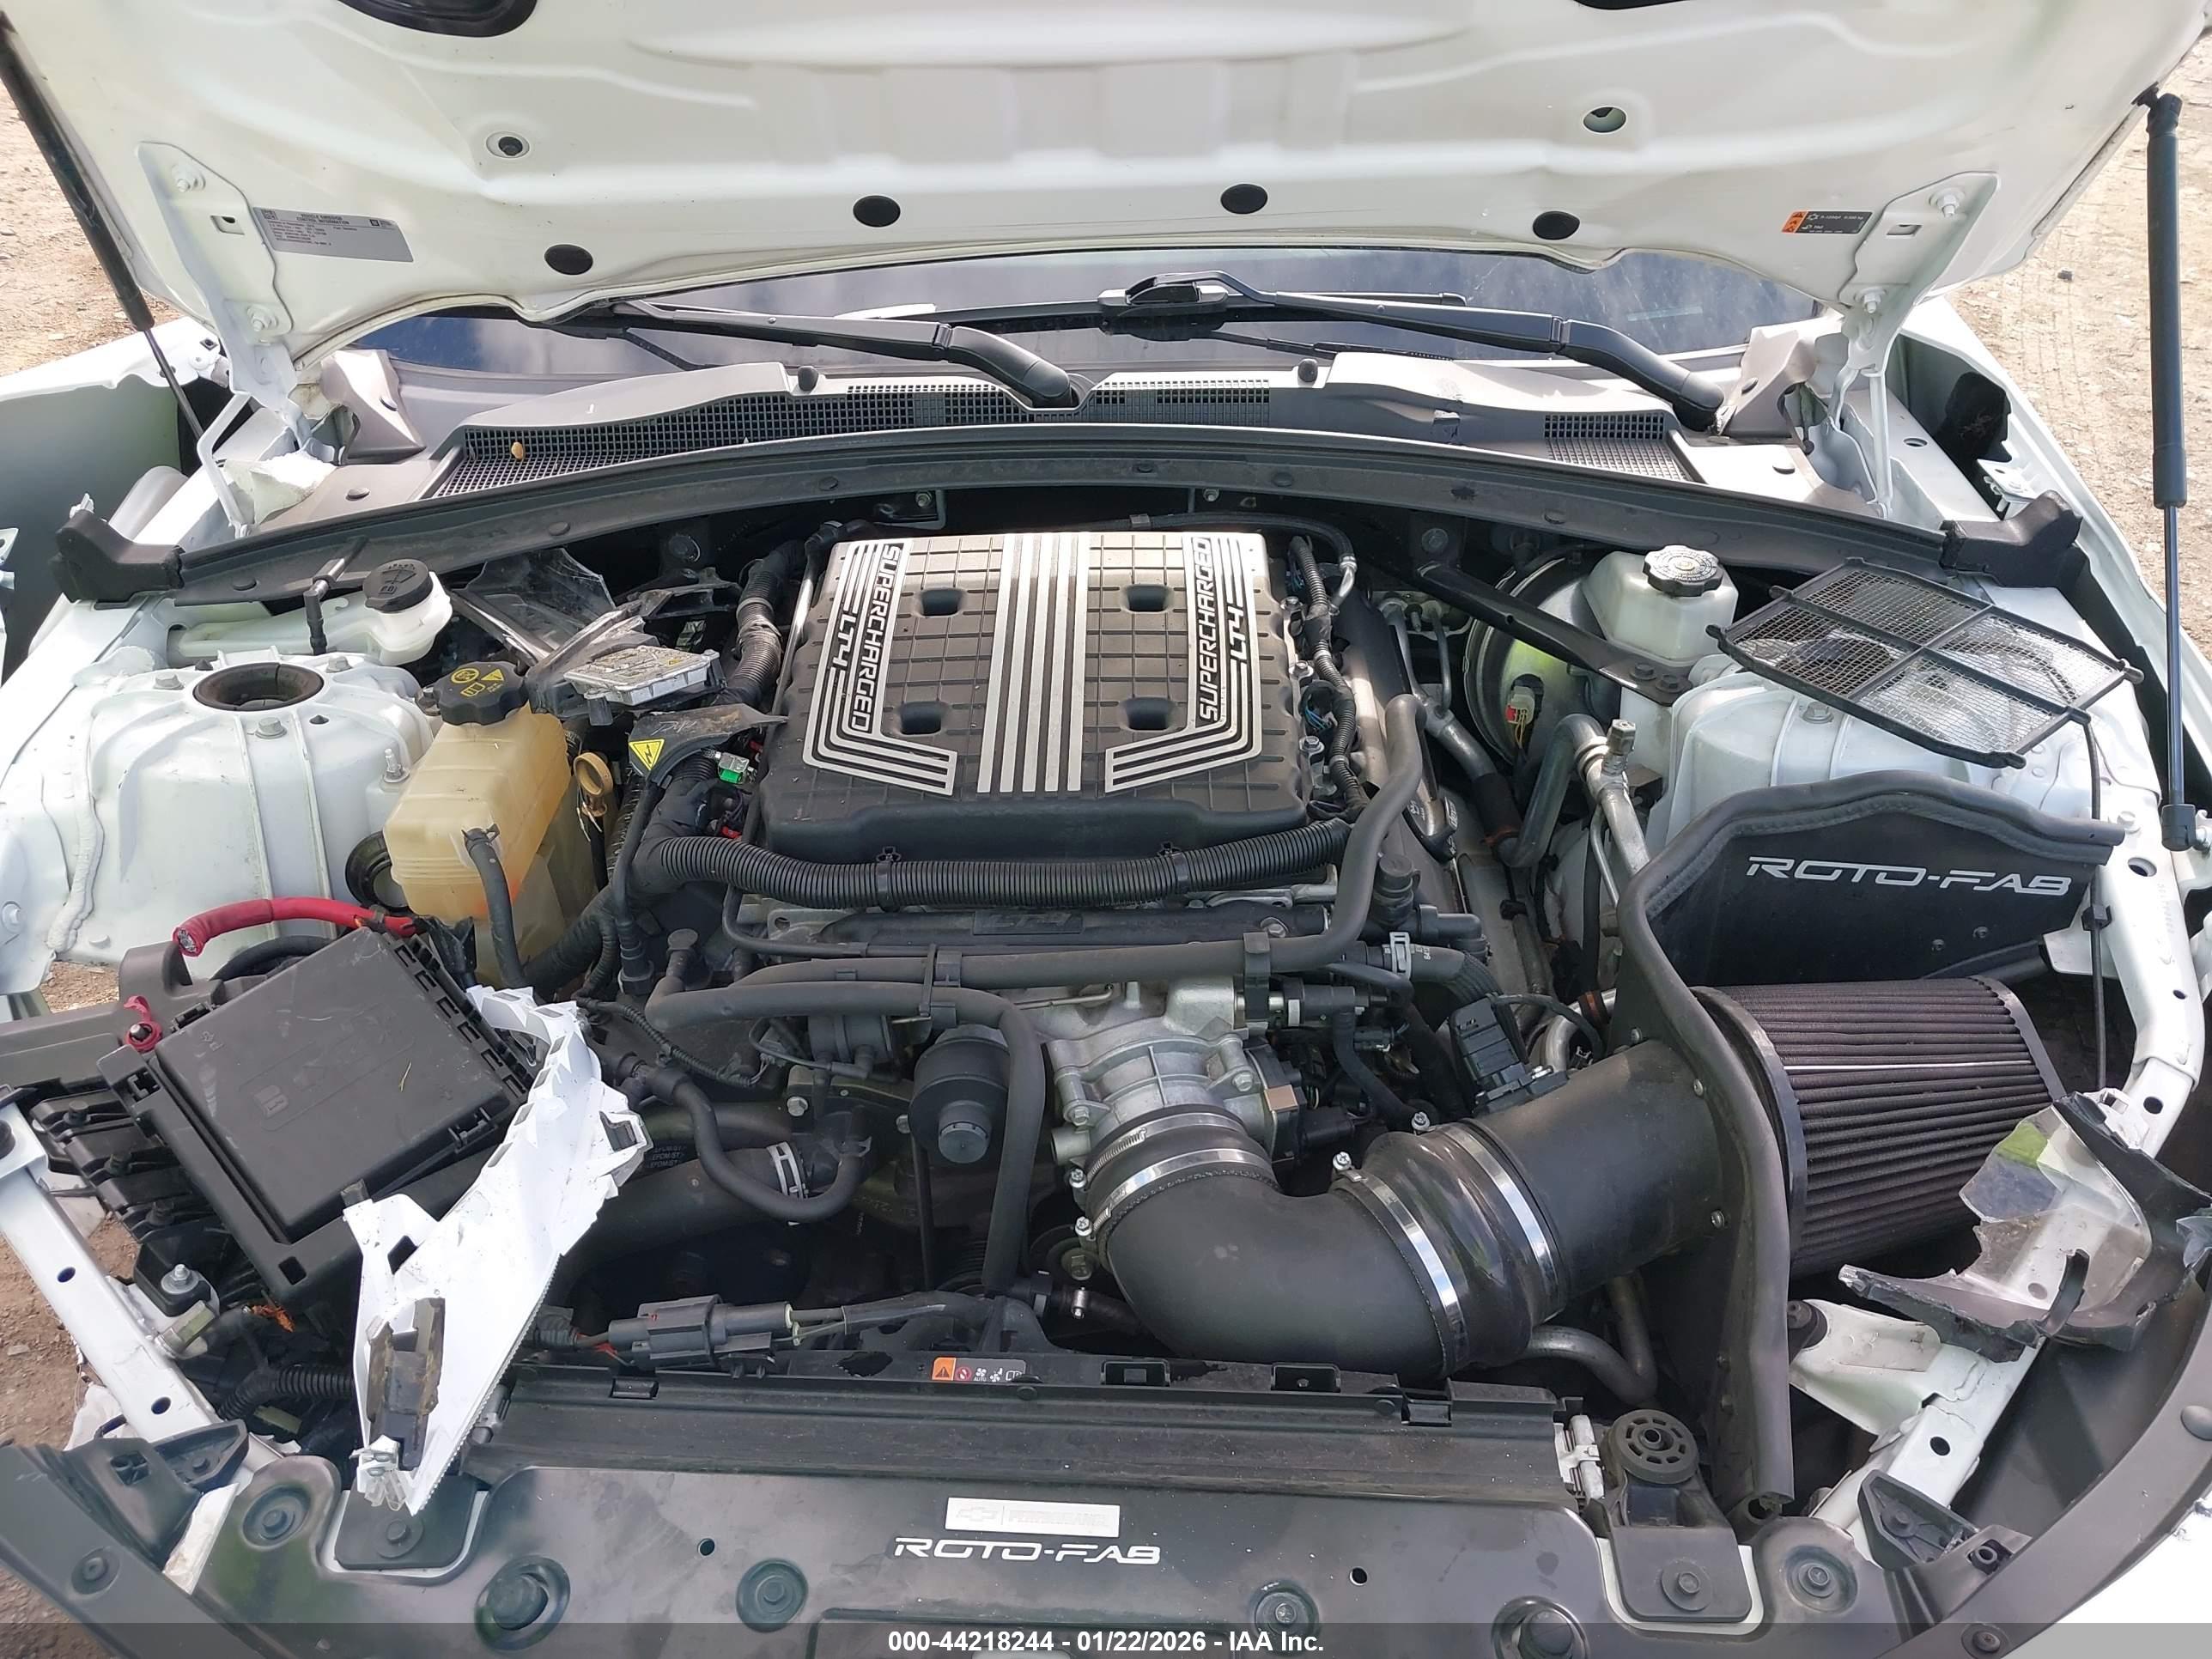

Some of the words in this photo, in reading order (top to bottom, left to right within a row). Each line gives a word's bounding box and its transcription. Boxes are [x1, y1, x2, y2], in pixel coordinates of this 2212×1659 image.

[833, 613, 856, 667] LT4
[851, 544, 901, 733] SUPERCHARGED
[1193, 537, 1218, 721] SUPERCHARGED
[1227, 606, 1248, 660] LT4
[1746, 856, 2072, 896] ROTO-FAB
[894, 1537, 1160, 1565] ROTO-FAB
